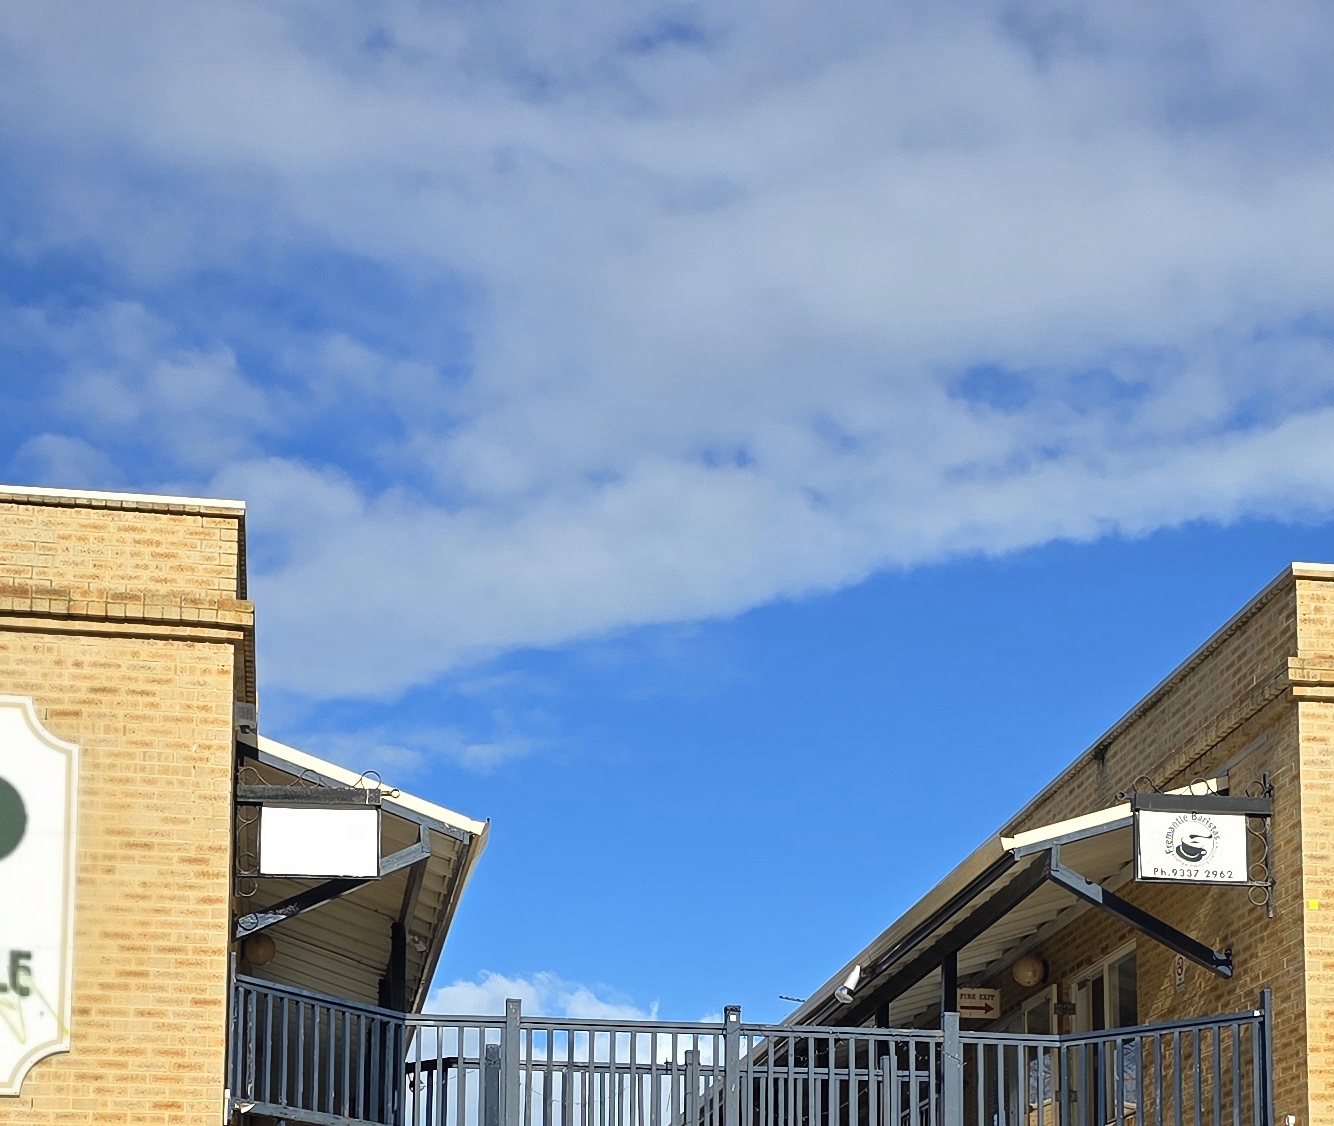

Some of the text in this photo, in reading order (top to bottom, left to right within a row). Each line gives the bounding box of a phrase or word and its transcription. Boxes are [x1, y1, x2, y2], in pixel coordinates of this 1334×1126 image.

[1164, 814, 1188, 855] Fremantle
[1191, 811, 1221, 841] Baristas
[1204, 869, 1234, 879] 2962
[979, 993, 996, 1001] EXIT
